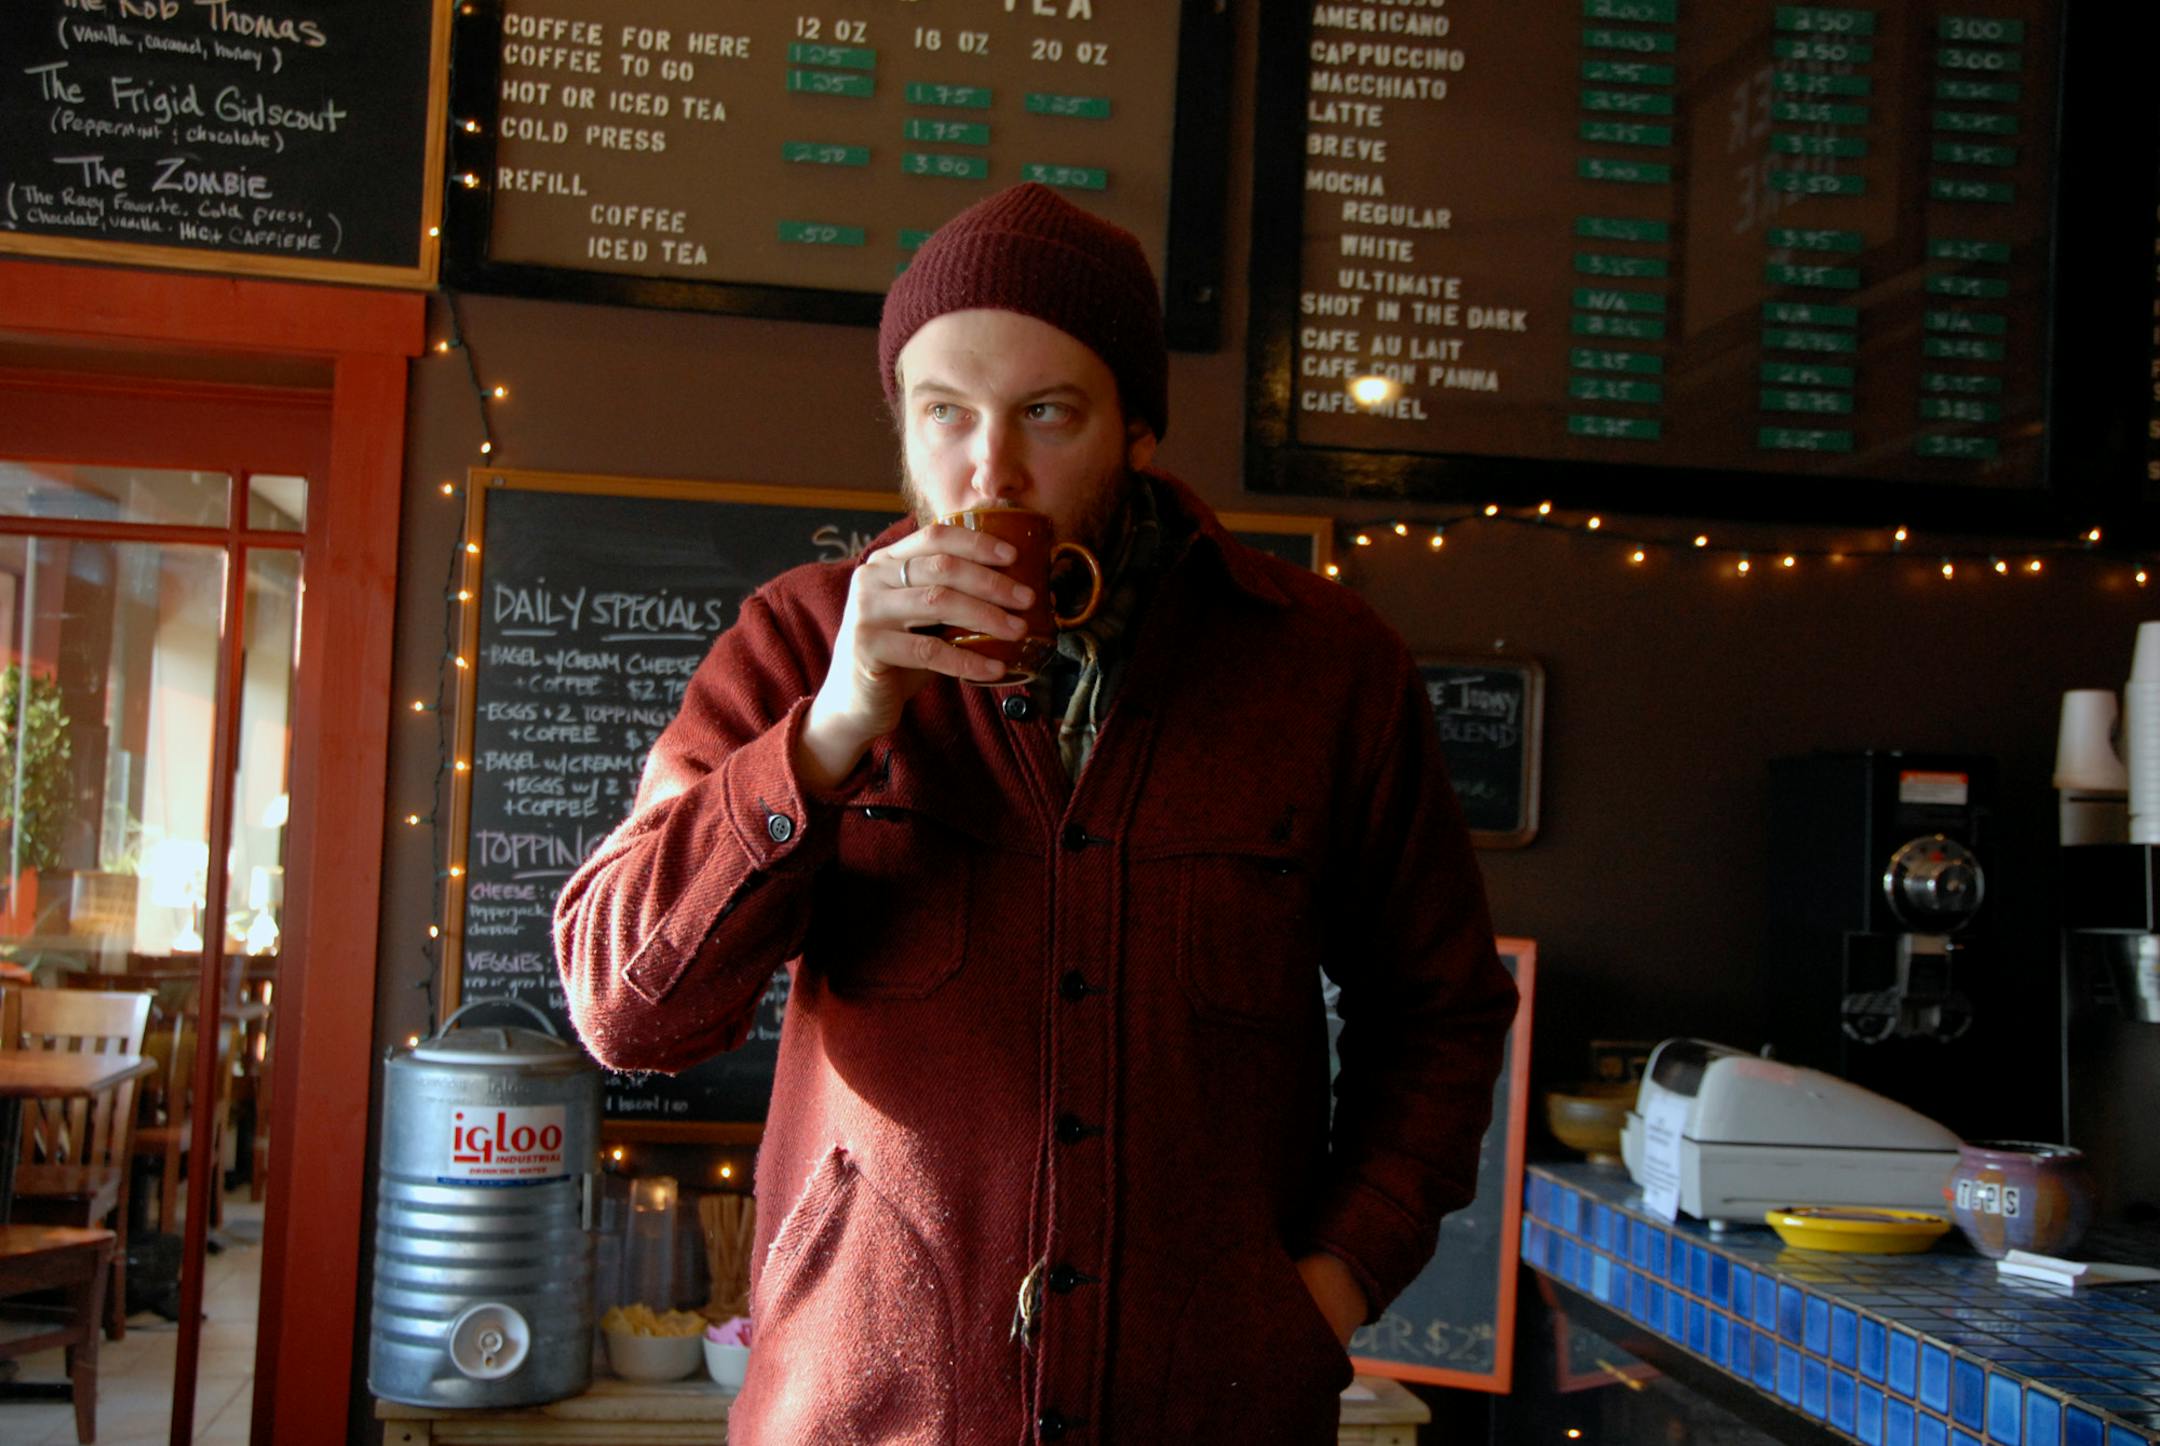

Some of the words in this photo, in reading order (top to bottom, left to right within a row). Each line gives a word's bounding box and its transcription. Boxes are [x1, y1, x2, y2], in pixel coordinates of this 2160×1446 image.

[193, 0, 328, 47] Thomas
[504, 14, 603, 46] COFFEE
[621, 26, 671, 52] FOR
[687, 32, 750, 59] HERE
[796, 15, 822, 41] 12
[834, 19, 868, 44] OZ
[1313, 5, 1450, 38] AMERICANO
[957, 29, 989, 56] OZ
[1031, 38, 1063, 63] 20
[1075, 41, 1109, 67] OZ
[1309, 39, 1466, 73] CAPPUCCINO
[504, 44, 602, 75] COFFEE
[620, 53, 650, 78] TO
[661, 58, 695, 82] GO
[25, 61, 86, 104] The
[109, 76, 205, 124] Frigid
[501, 80, 551, 106] HOT
[562, 84, 596, 110] OR
[609, 91, 670, 118] ICED
[682, 97, 727, 123] TEA
[1309, 69, 1448, 101] MACCHIATO
[1307, 99, 1385, 129] LATTE
[501, 116, 569, 145] COLD
[585, 125, 666, 153] PRESS
[1306, 132, 1388, 164] BREVE
[53, 156, 127, 190] The
[498, 167, 588, 198] REFILL
[1304, 168, 1386, 198] MOCHA
[590, 203, 687, 235] COFFEE
[1341, 200, 1453, 231] REGULAR
[587, 237, 648, 263] ICED
[660, 241, 708, 266] TEA
[1339, 233, 1416, 264] WHITE
[1337, 269, 1463, 302] ULTIMATE
[1300, 289, 1365, 318] SHOT
[1375, 300, 1400, 322] IN
[1411, 303, 1460, 328] THE
[1465, 307, 1529, 334] DARK
[1300, 326, 1360, 354] CAFE
[1370, 335, 1402, 356] AU
[1409, 337, 1464, 361] LAIT
[1300, 355, 1357, 381] CAFE
[1428, 366, 1499, 393] PANNA
[1300, 390, 1357, 415] CAFE
[491, 575, 588, 632] DAILY
[589, 586, 723, 632] SPECIALS
[453, 1109, 563, 1163] igloo
